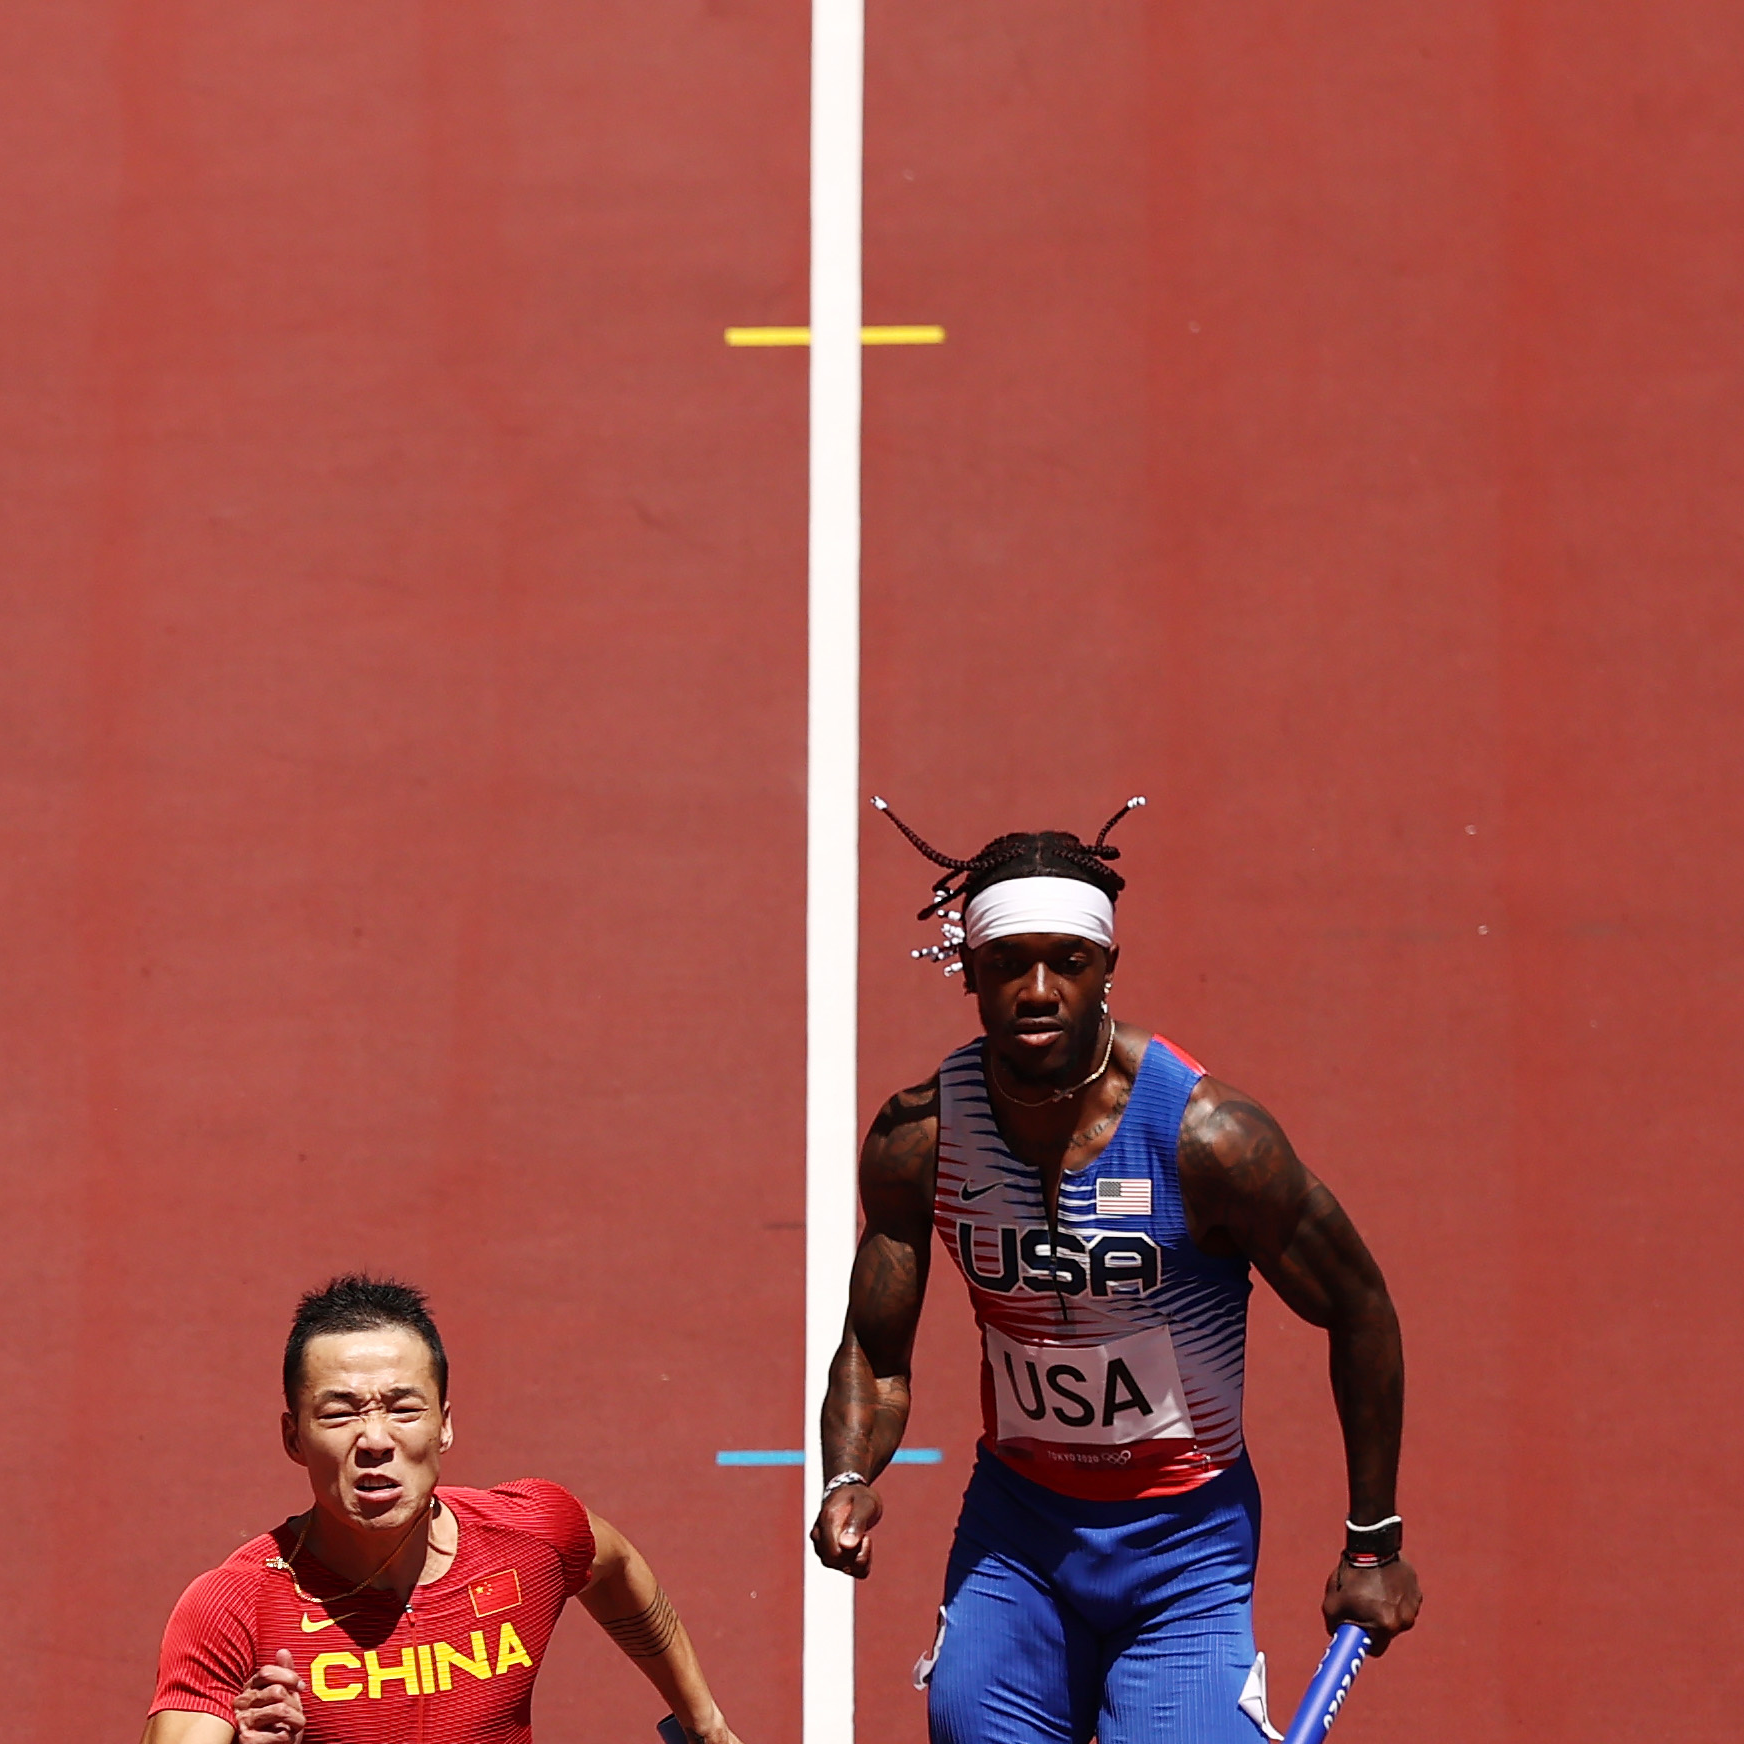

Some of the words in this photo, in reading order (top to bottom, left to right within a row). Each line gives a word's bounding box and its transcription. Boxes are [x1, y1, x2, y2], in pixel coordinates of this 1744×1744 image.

[956, 1218, 1161, 1298] USA
[1003, 1350, 1154, 1428] USA
[1047, 1451, 1076, 1461] TOKYO
[1076, 1453, 1099, 1463] 2020
[310, 1622, 533, 1701] CHINA
